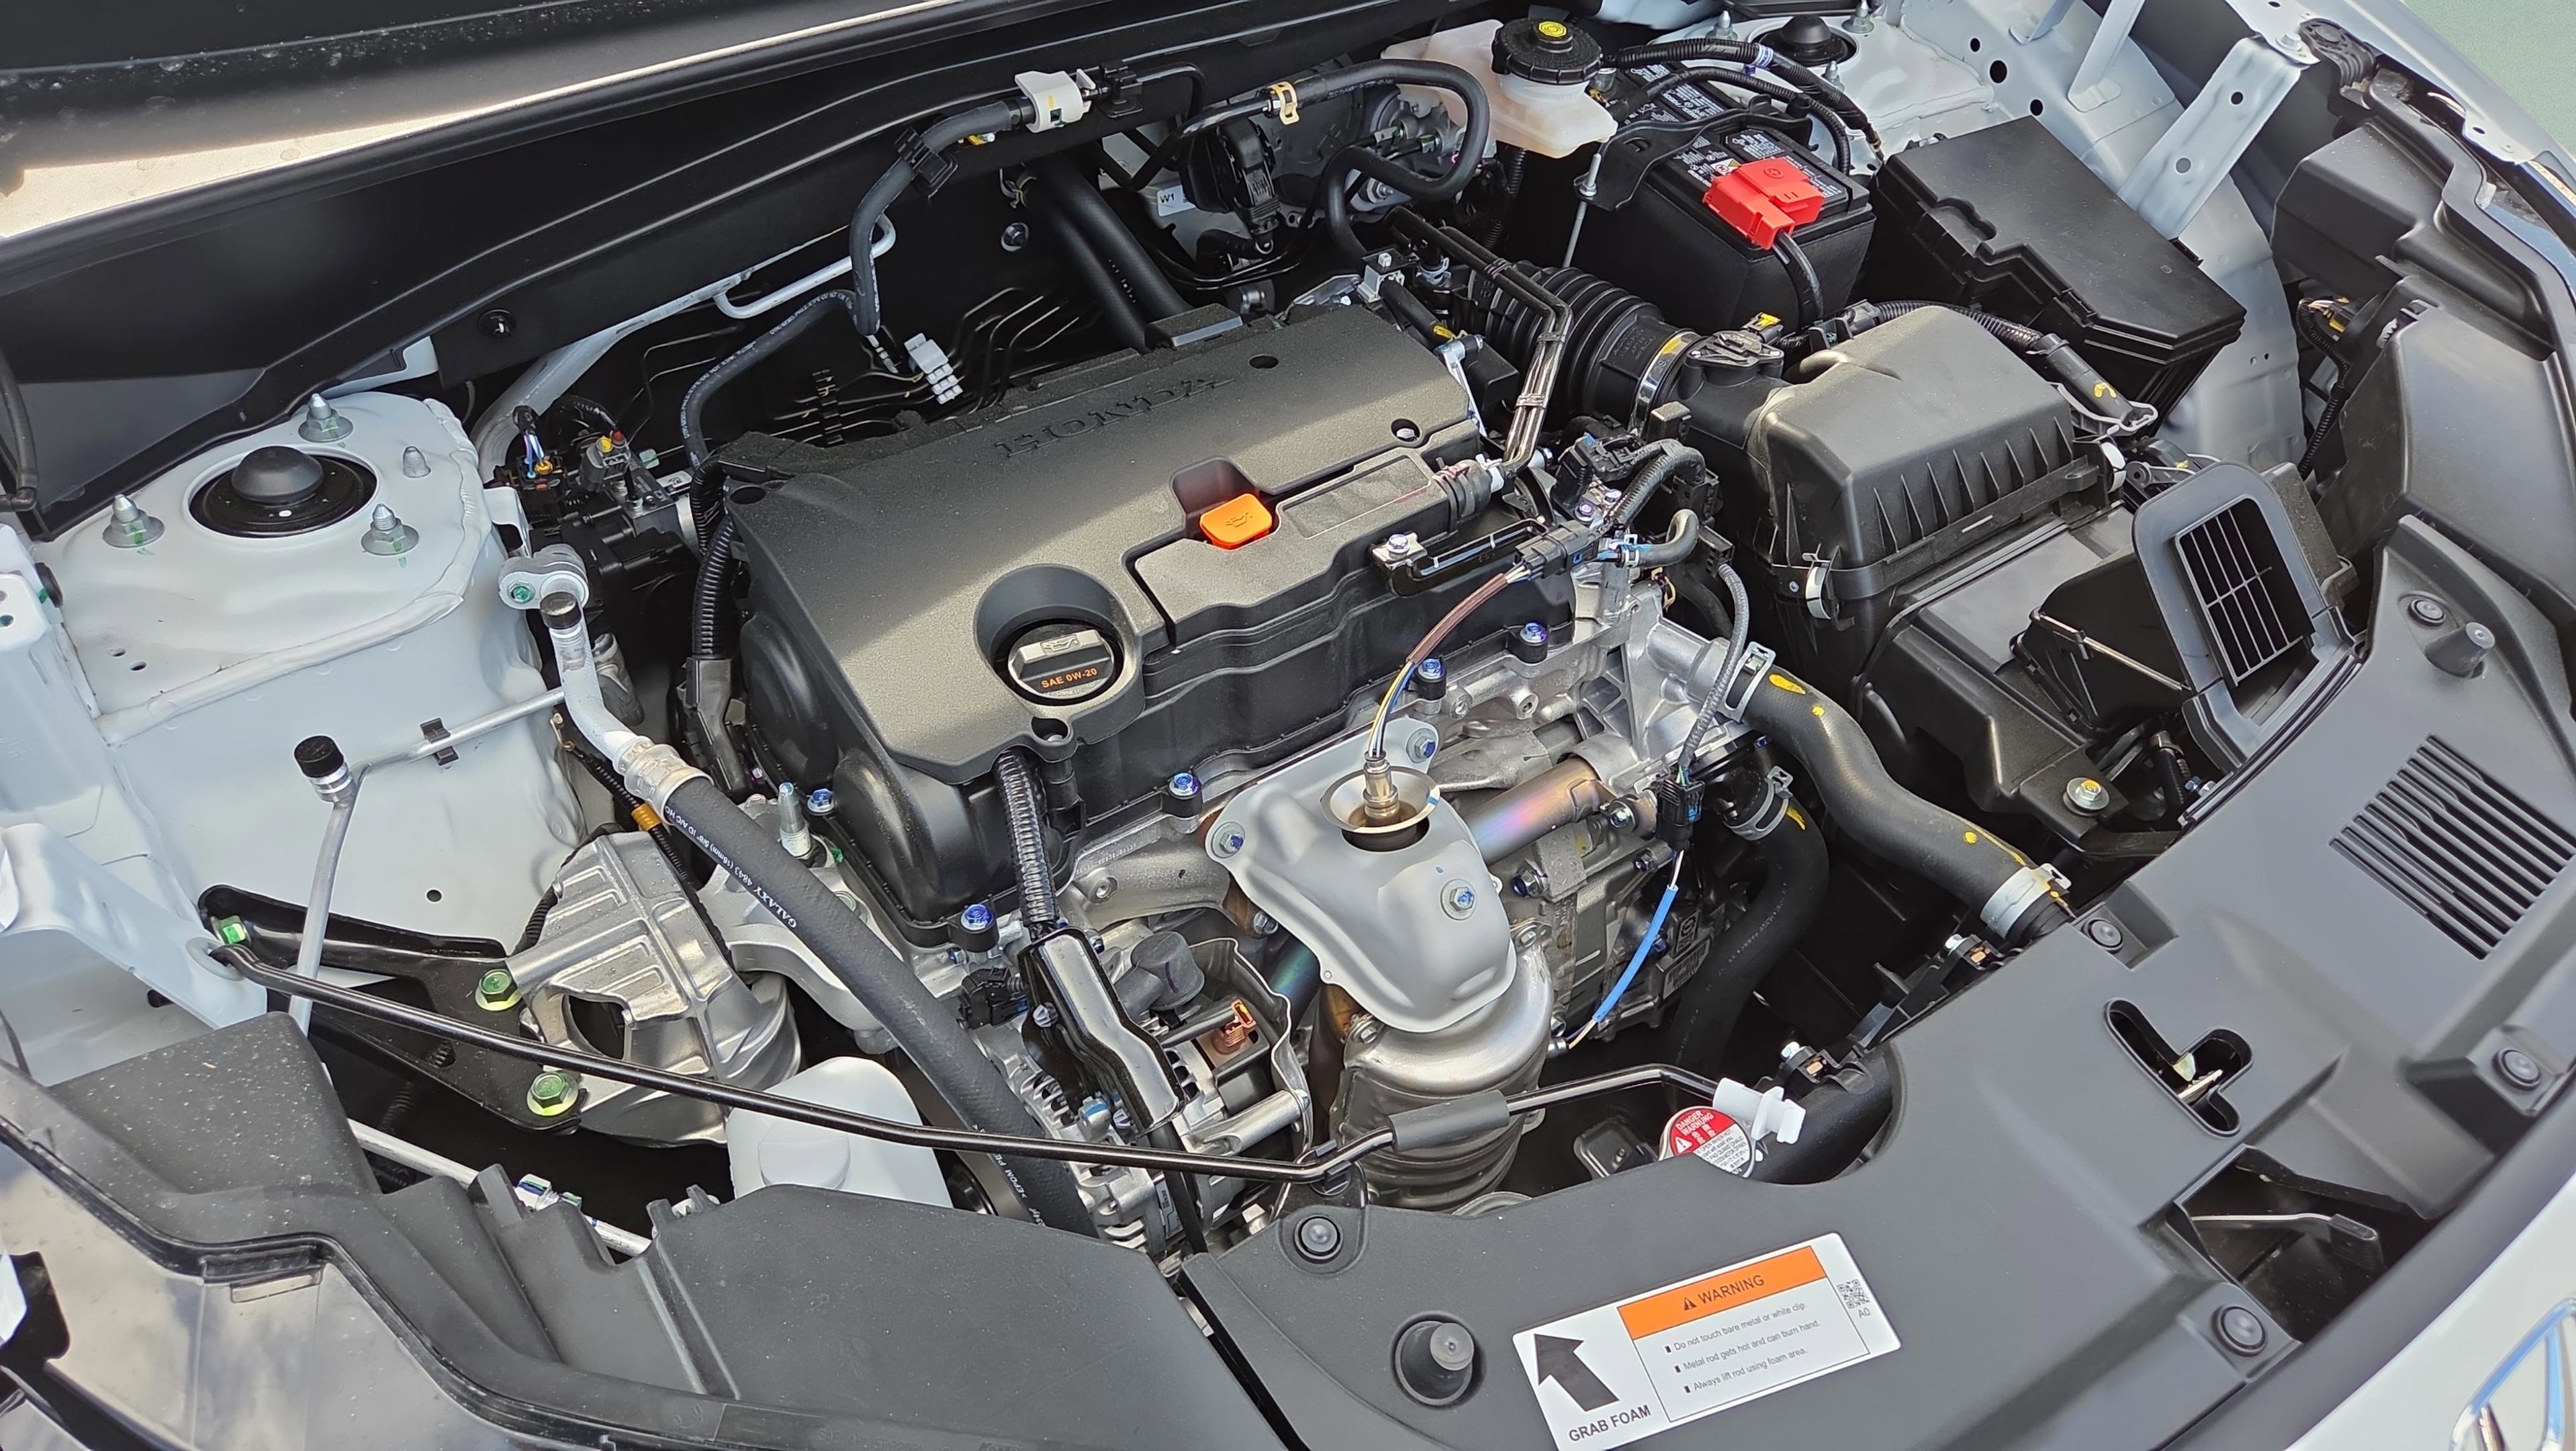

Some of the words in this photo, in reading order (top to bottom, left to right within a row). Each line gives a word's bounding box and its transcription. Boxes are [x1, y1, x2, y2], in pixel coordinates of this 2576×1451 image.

[1160, 193, 1175, 203] W1
[995, 378, 1235, 457] HONDA
[1041, 676, 1064, 688] SAE
[1066, 668, 1097, 683] 0W-20
[676, 815, 688, 829] A/C
[688, 826, 696, 836] ID
[735, 867, 753, 887] 4843
[753, 886, 797, 928] GALAXY
[1675, 1110, 1704, 1130] DANGER
[1680, 1112, 1714, 1136] WARNUNG
[1698, 1275, 1764, 1304] WARNING
[1673, 1342, 1686, 1350] Do
[1687, 1337, 1700, 1346] not
[1700, 1329, 1722, 1342] touch
[1721, 1323, 1740, 1334] bare
[1741, 1316, 1761, 1328] metal
[1772, 1307, 1792, 1318] white
[1792, 1303, 1808, 1312] clip.
[1683, 1357, 1705, 1370] Metal
[1706, 1353, 1719, 1363] rod
[1720, 1348, 1737, 1360] gets
[1737, 1343, 1751, 1352] hot
[1751, 1337, 1765, 1348] and
[1767, 1333, 1780, 1342] can
[1781, 1327, 1799, 1337] burn
[1800, 1319, 1821, 1331] hand.
[1694, 1376, 1721, 1391] Always
[1721, 1372, 1732, 1380] lift
[1733, 1367, 1745, 1377] rod
[1746, 1361, 1768, 1372] using
[1768, 1354, 1787, 1365] foam
[1789, 1348, 1808, 1358] area.
[1569, 1419, 1609, 1442] GRAB
[1610, 1405, 1651, 1427] FOAM
